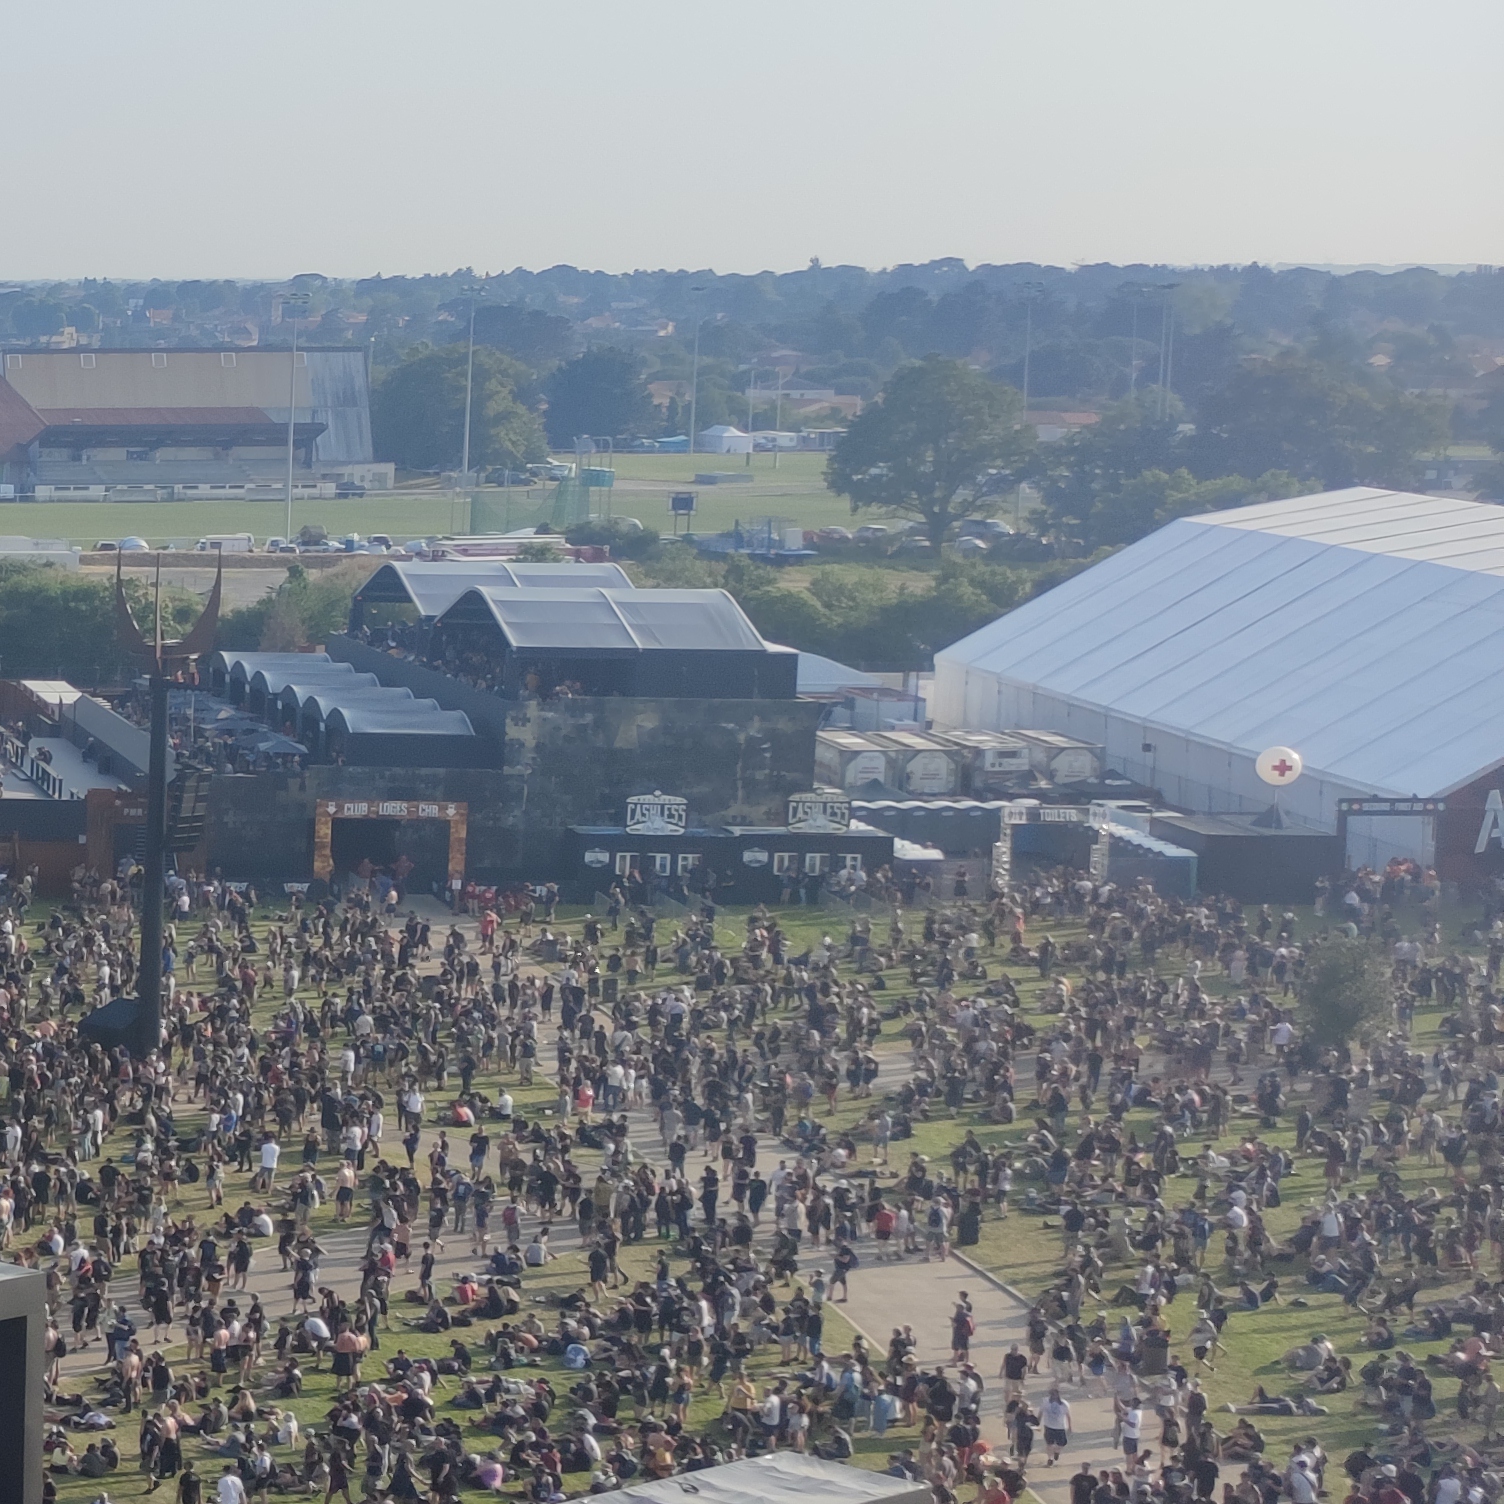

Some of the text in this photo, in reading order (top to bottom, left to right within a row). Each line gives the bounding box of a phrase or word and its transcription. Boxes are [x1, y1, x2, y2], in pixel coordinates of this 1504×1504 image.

[344, 803, 368, 815] CLUB
[379, 803, 408, 816] LOGES
[627, 804, 687, 826] CASHLESS
[789, 802, 849, 825] CASHLESS
[1040, 809, 1078, 822] TOILETS
